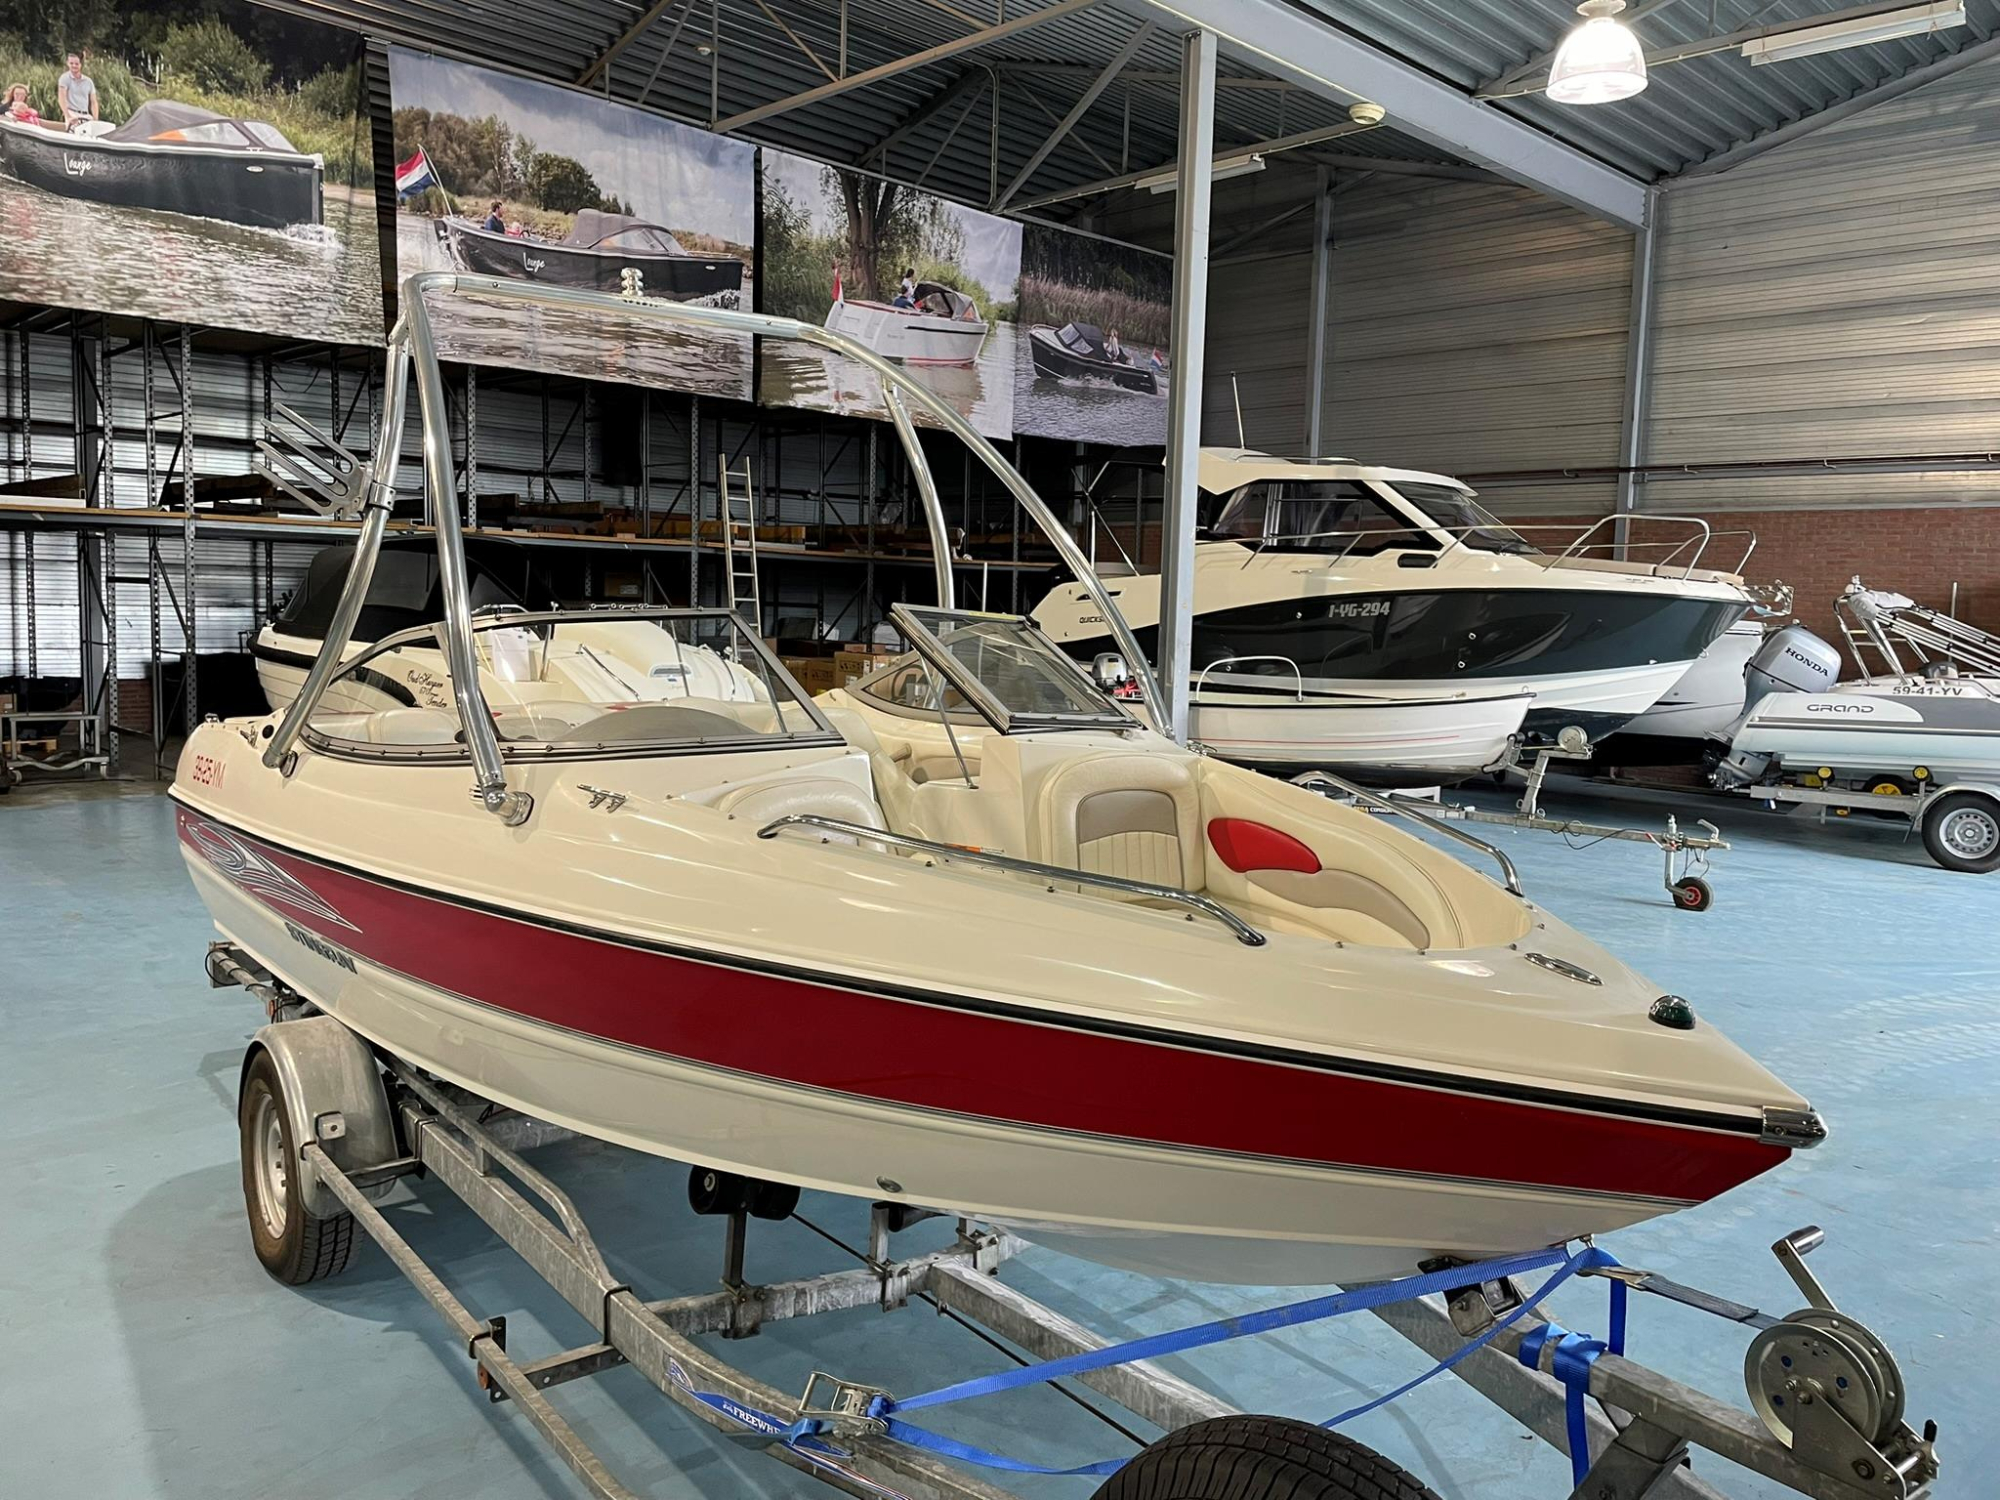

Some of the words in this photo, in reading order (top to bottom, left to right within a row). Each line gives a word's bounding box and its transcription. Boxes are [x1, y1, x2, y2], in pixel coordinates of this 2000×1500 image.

[63, 152, 92, 177] Lounge
[523, 252, 546, 273] Lounge
[1785, 647, 1829, 677] HONDA
